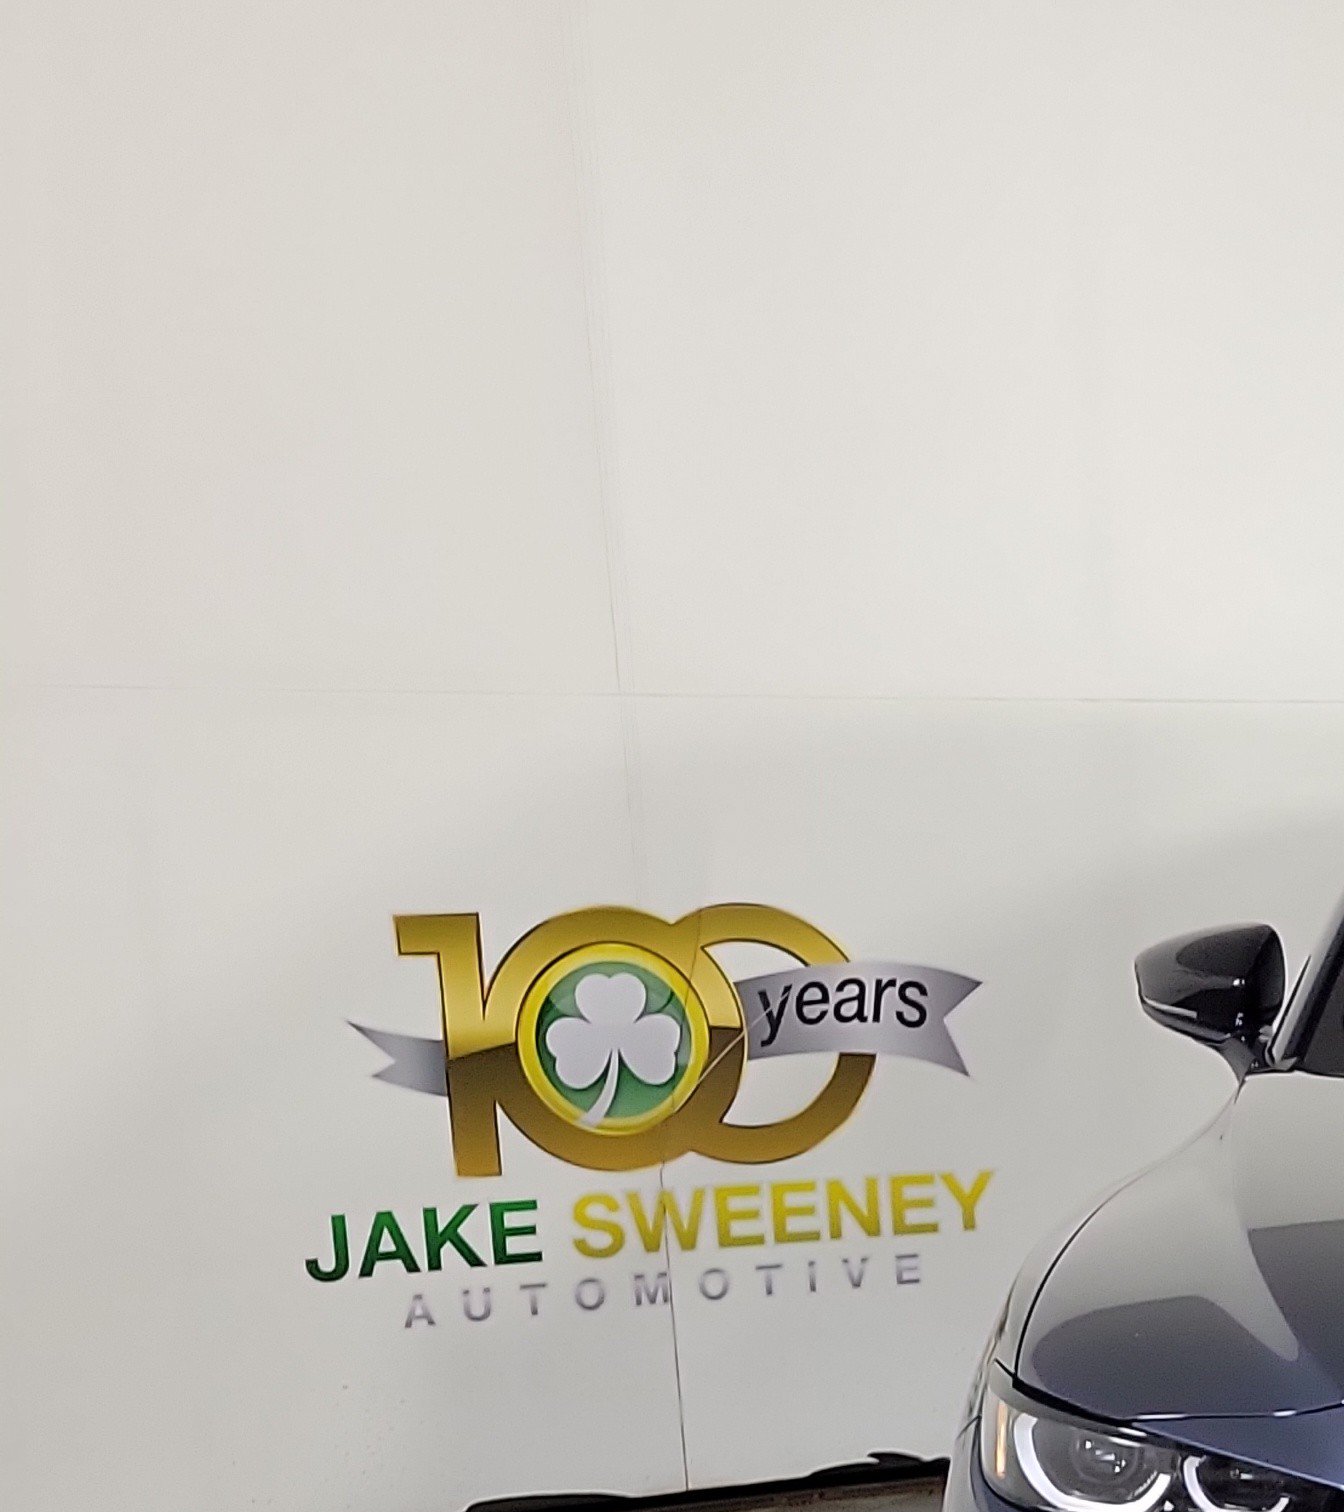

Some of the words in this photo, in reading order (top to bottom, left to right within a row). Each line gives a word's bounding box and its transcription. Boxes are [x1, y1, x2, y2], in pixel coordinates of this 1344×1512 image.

[392, 902, 877, 1177] 100
[757, 974, 929, 1048] years
[304, 1199, 543, 1283] JAKE
[571, 1171, 994, 1259] SWEENEY
[404, 1254, 922, 1329] AUTOMOTIVE
